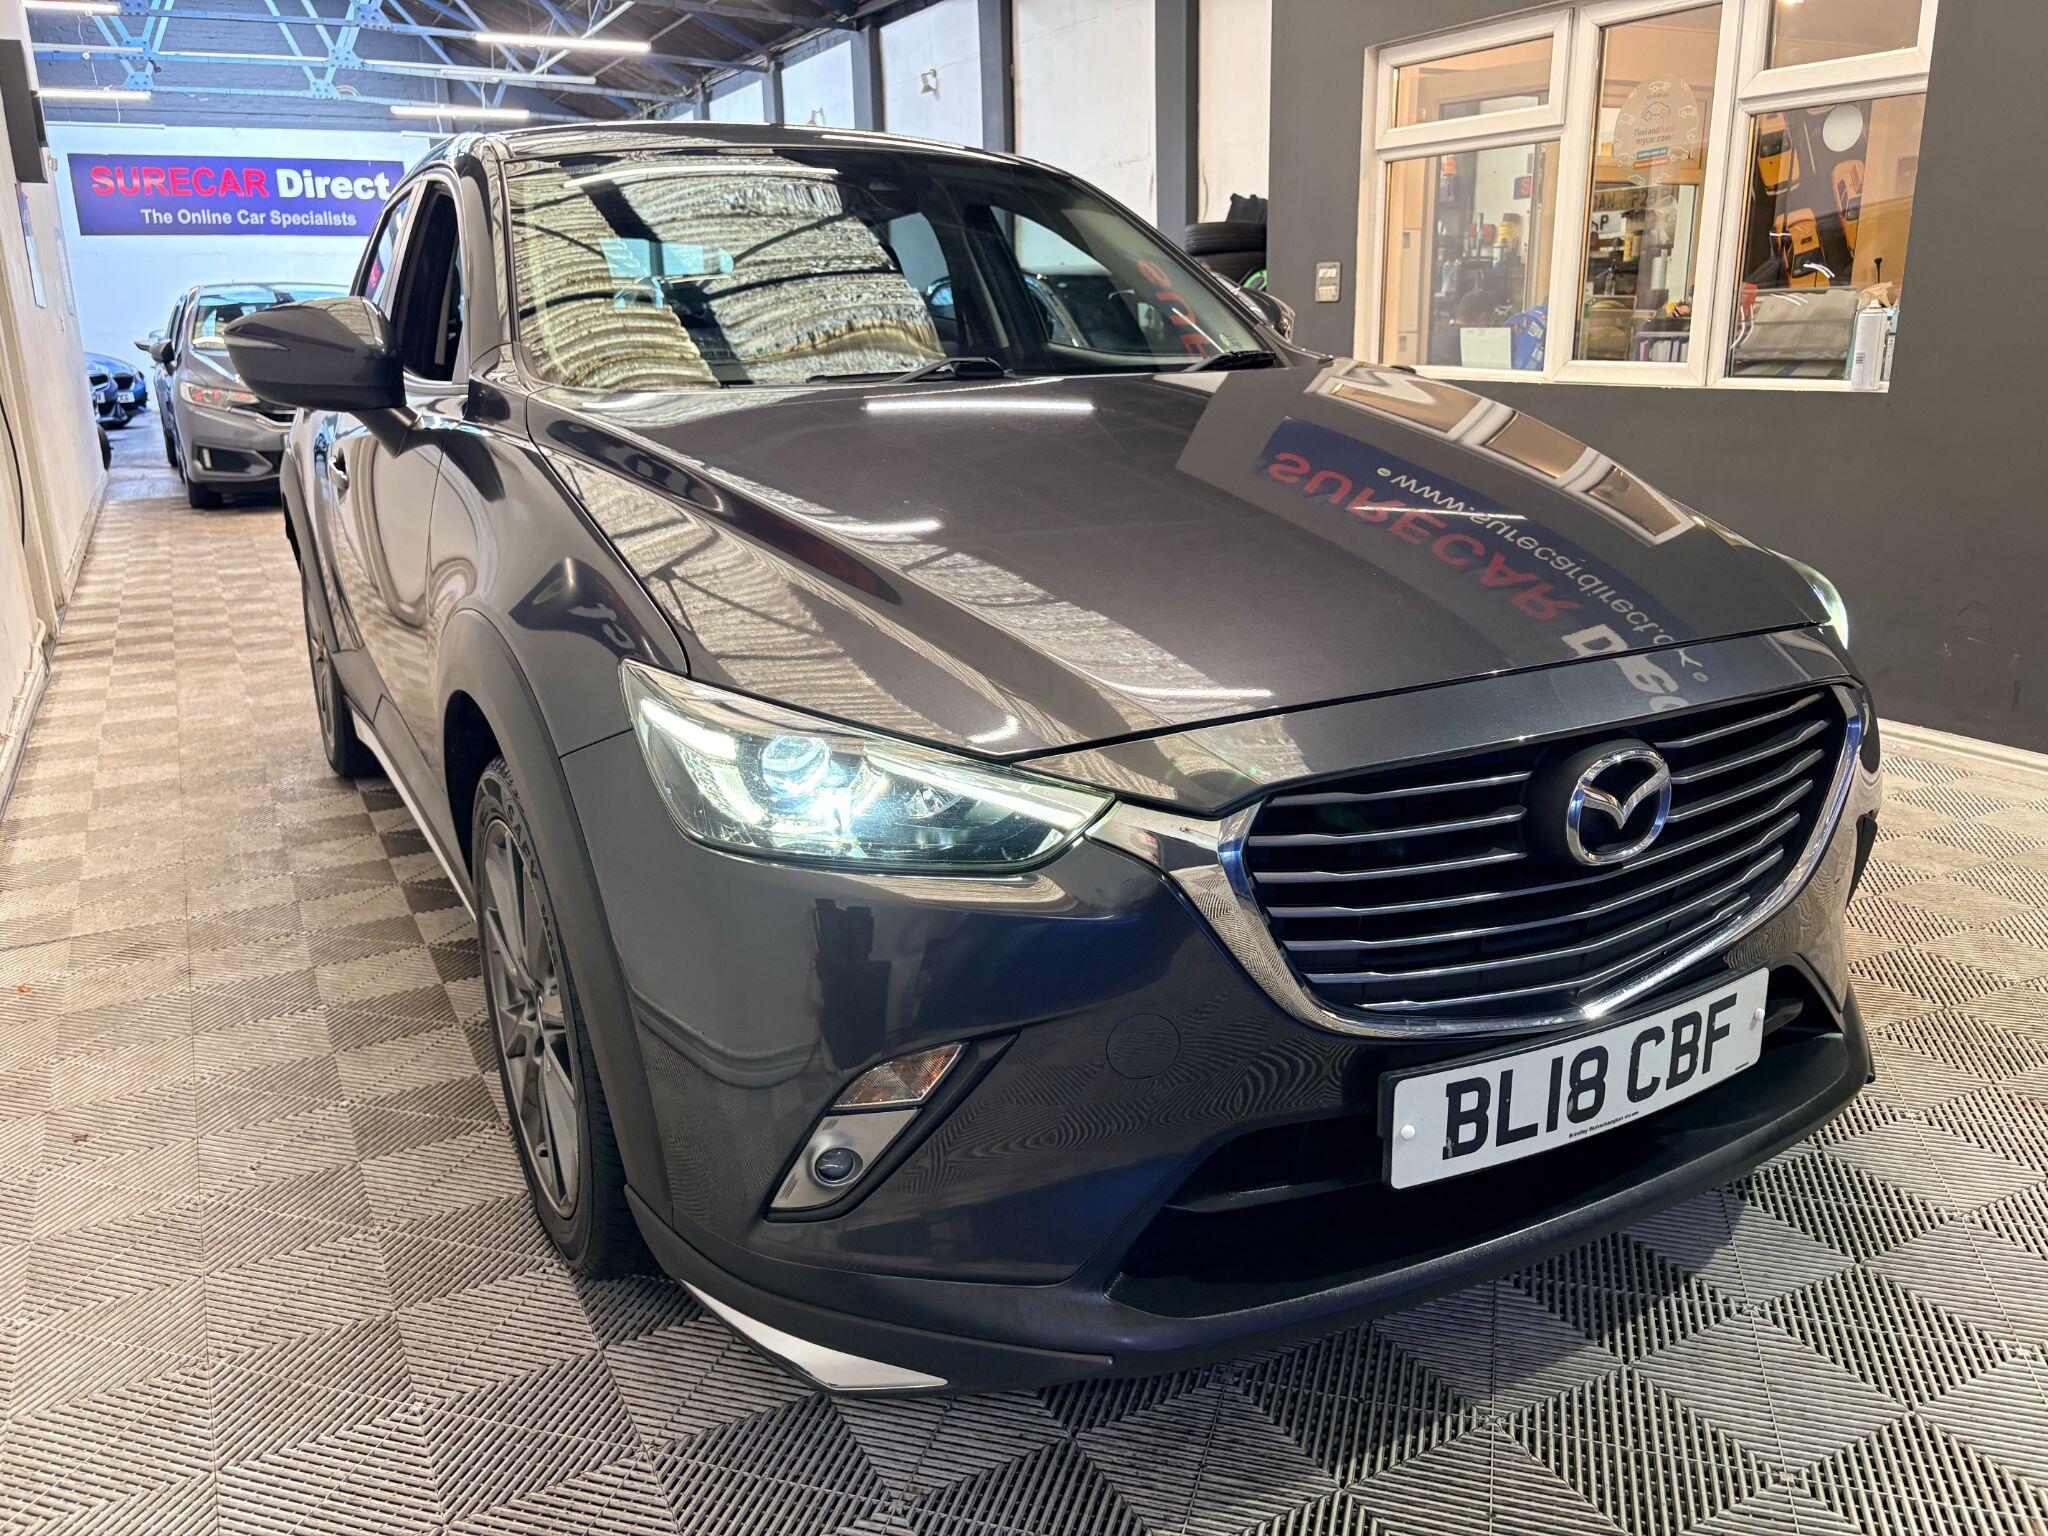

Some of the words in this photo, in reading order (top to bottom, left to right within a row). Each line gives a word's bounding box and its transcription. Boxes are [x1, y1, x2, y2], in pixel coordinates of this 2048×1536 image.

[91, 166, 269, 198] SURECAR
[276, 168, 392, 200] Direct
[140, 208, 173, 224] The
[177, 208, 232, 225] Online
[237, 209, 265, 225] Car
[270, 209, 357, 228] Specialists
[1442, 1045, 1609, 1160] BL18
[1626, 992, 1738, 1103] CBF
[1568, 1128, 1588, 1139] Brindley
